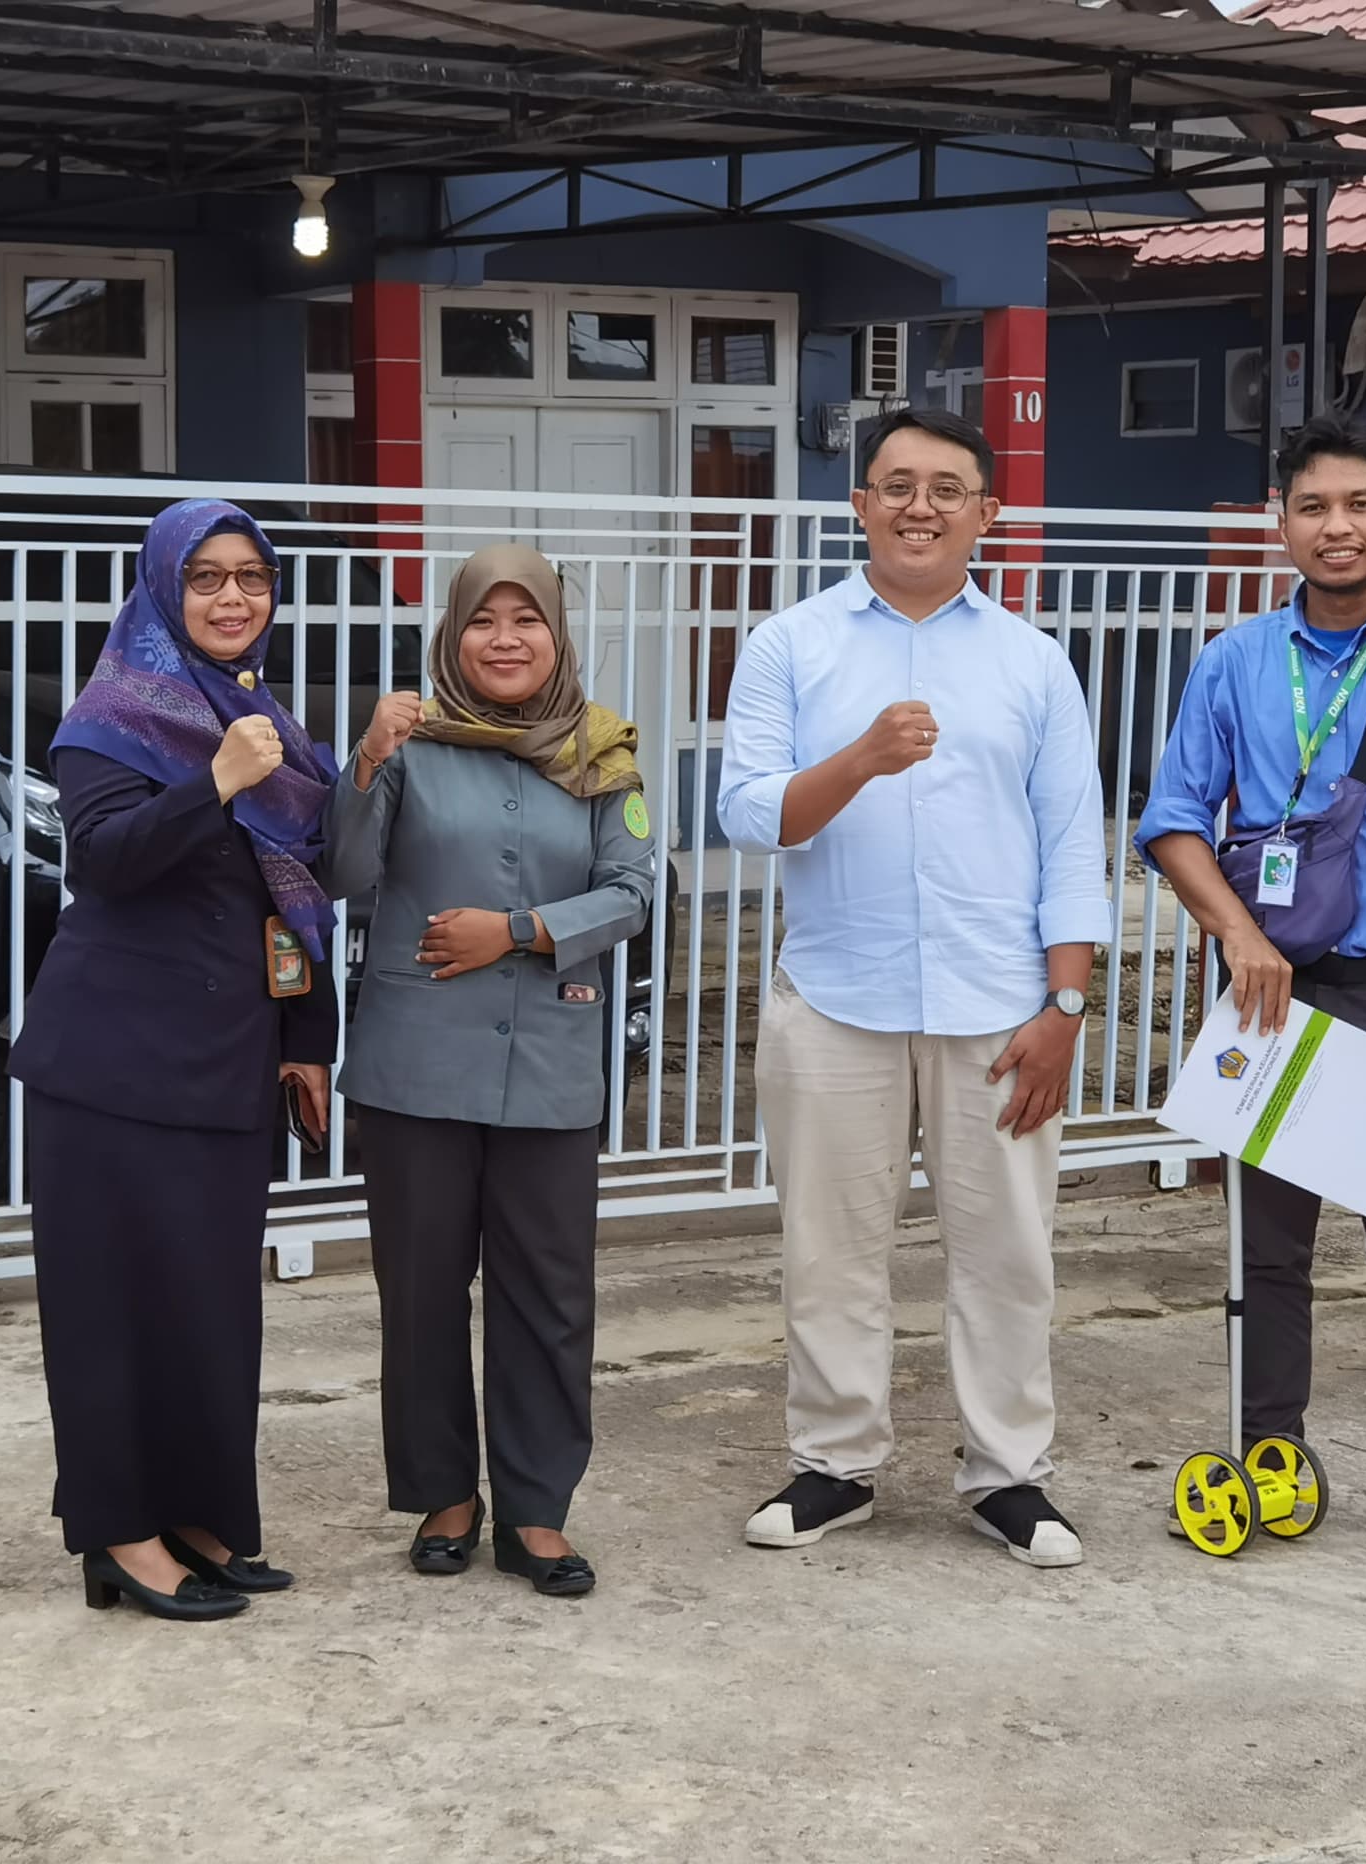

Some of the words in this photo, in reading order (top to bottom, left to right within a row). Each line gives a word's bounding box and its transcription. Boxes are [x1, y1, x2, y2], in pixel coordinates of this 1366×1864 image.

[1286, 375, 1299, 387] LG
[1012, 391, 1042, 423] 10
[1293, 687, 1306, 714] DJKN
[1328, 688, 1349, 718] DJKN
[1235, 1071, 1260, 1115] KEMENTERIAN
[1245, 1080, 1264, 1112] REPUBLIK
[1263, 1046, 1282, 1081] INDONESIA
